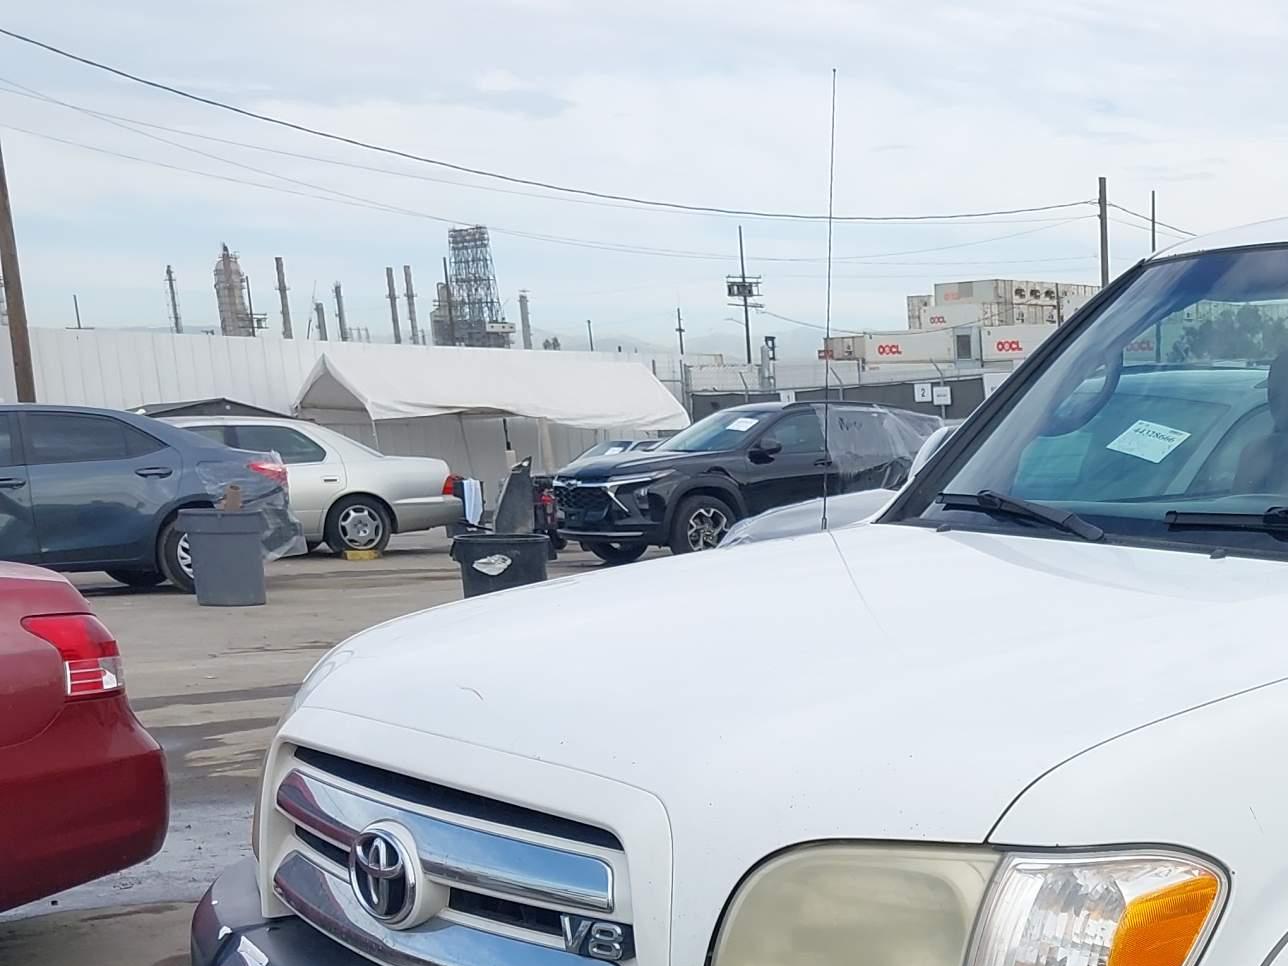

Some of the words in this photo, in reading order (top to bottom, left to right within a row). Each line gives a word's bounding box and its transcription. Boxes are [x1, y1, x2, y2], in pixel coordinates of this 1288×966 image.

[878, 344, 902, 356] OOCL
[996, 340, 1024, 352] OOCL
[920, 387, 927, 398] 2
[560, 915, 624, 960] V8
